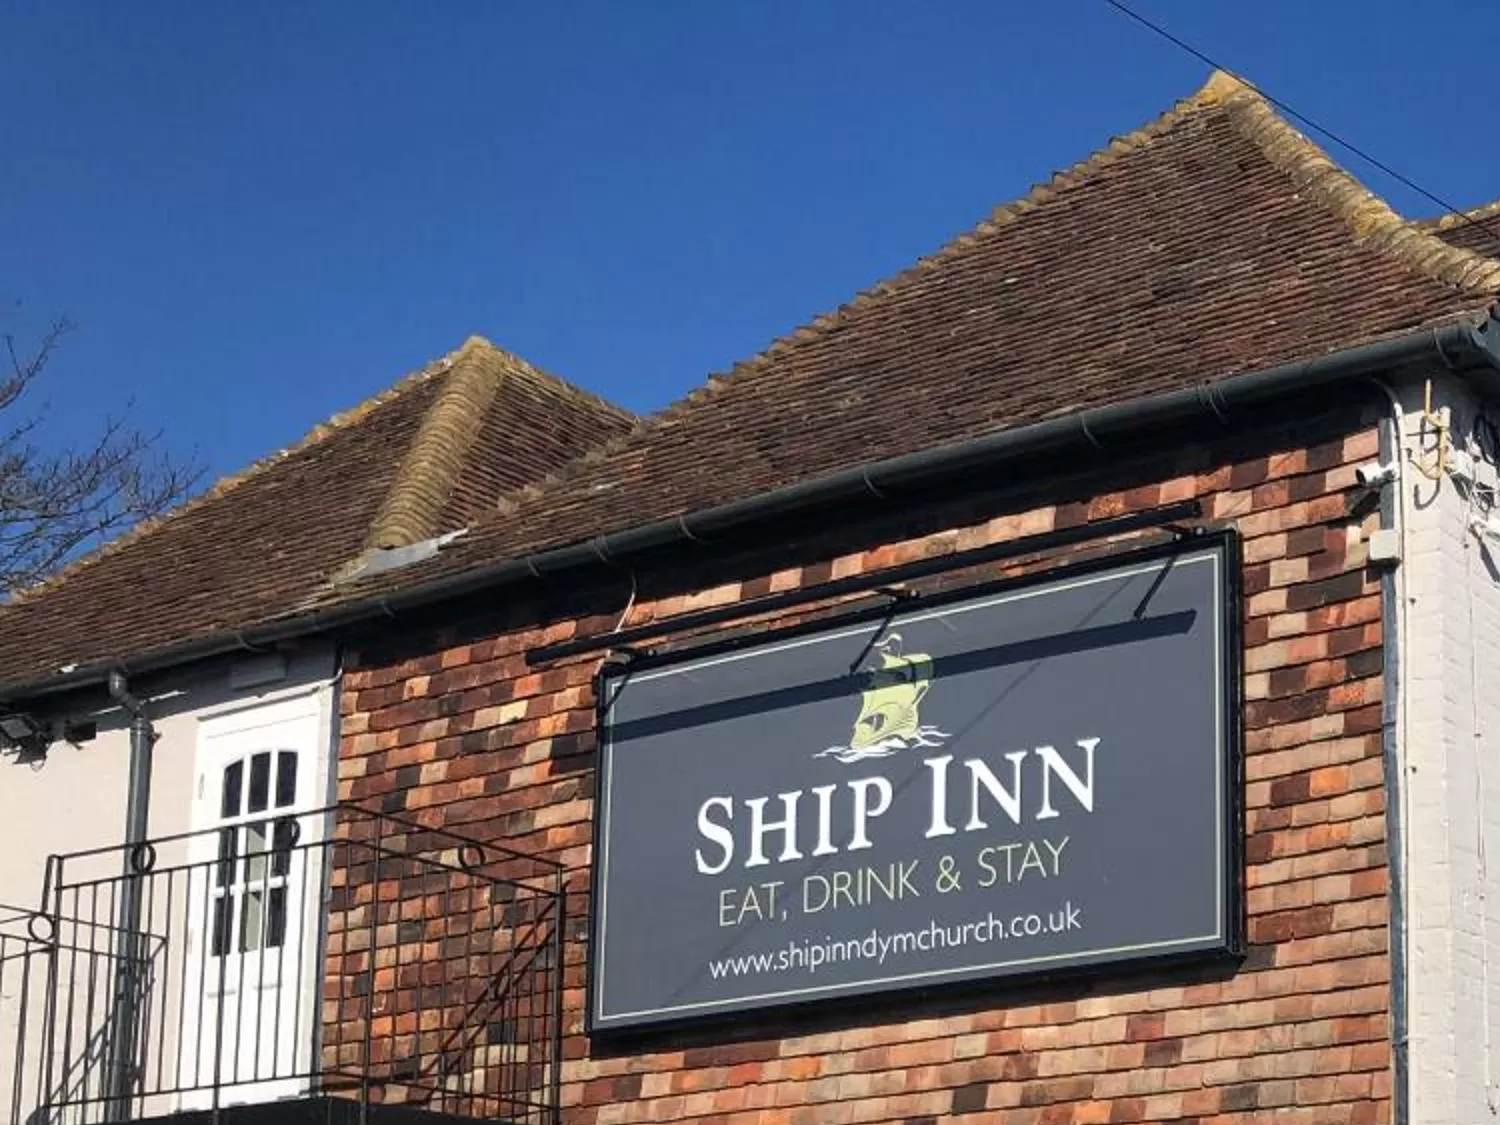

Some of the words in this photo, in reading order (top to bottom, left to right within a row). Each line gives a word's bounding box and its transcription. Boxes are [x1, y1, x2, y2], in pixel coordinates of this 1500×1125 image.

[695, 775, 893, 875] SHIP
[923, 737, 1101, 838] INN
[718, 881, 788, 927] EAT,
[803, 860, 920, 914] DRINK
[936, 856, 961, 892] &
[977, 837, 1070, 888] STAY
[709, 901, 1081, 979] www.shipinndymchurch.co.uk
